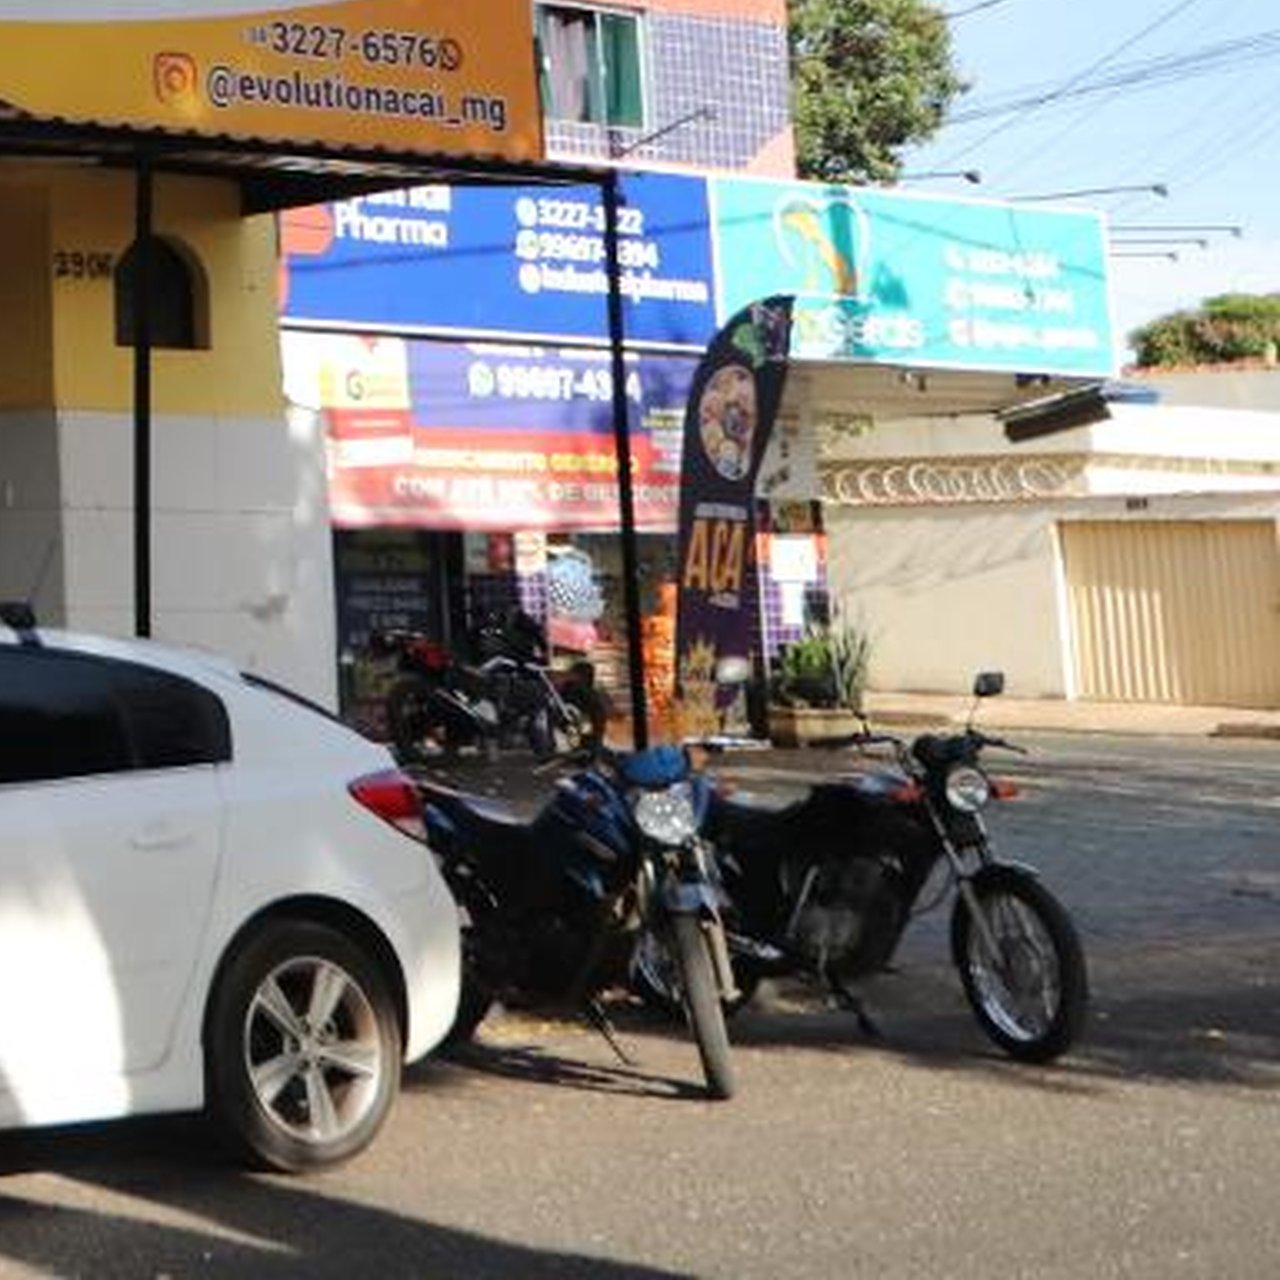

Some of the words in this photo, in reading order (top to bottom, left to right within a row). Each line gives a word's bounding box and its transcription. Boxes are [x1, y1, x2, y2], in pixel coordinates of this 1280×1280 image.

[271, 22, 438, 69] 3227-6576
[206, 64, 507, 132] @evolutionacai_mg
[334, 203, 448, 248] Pharma
